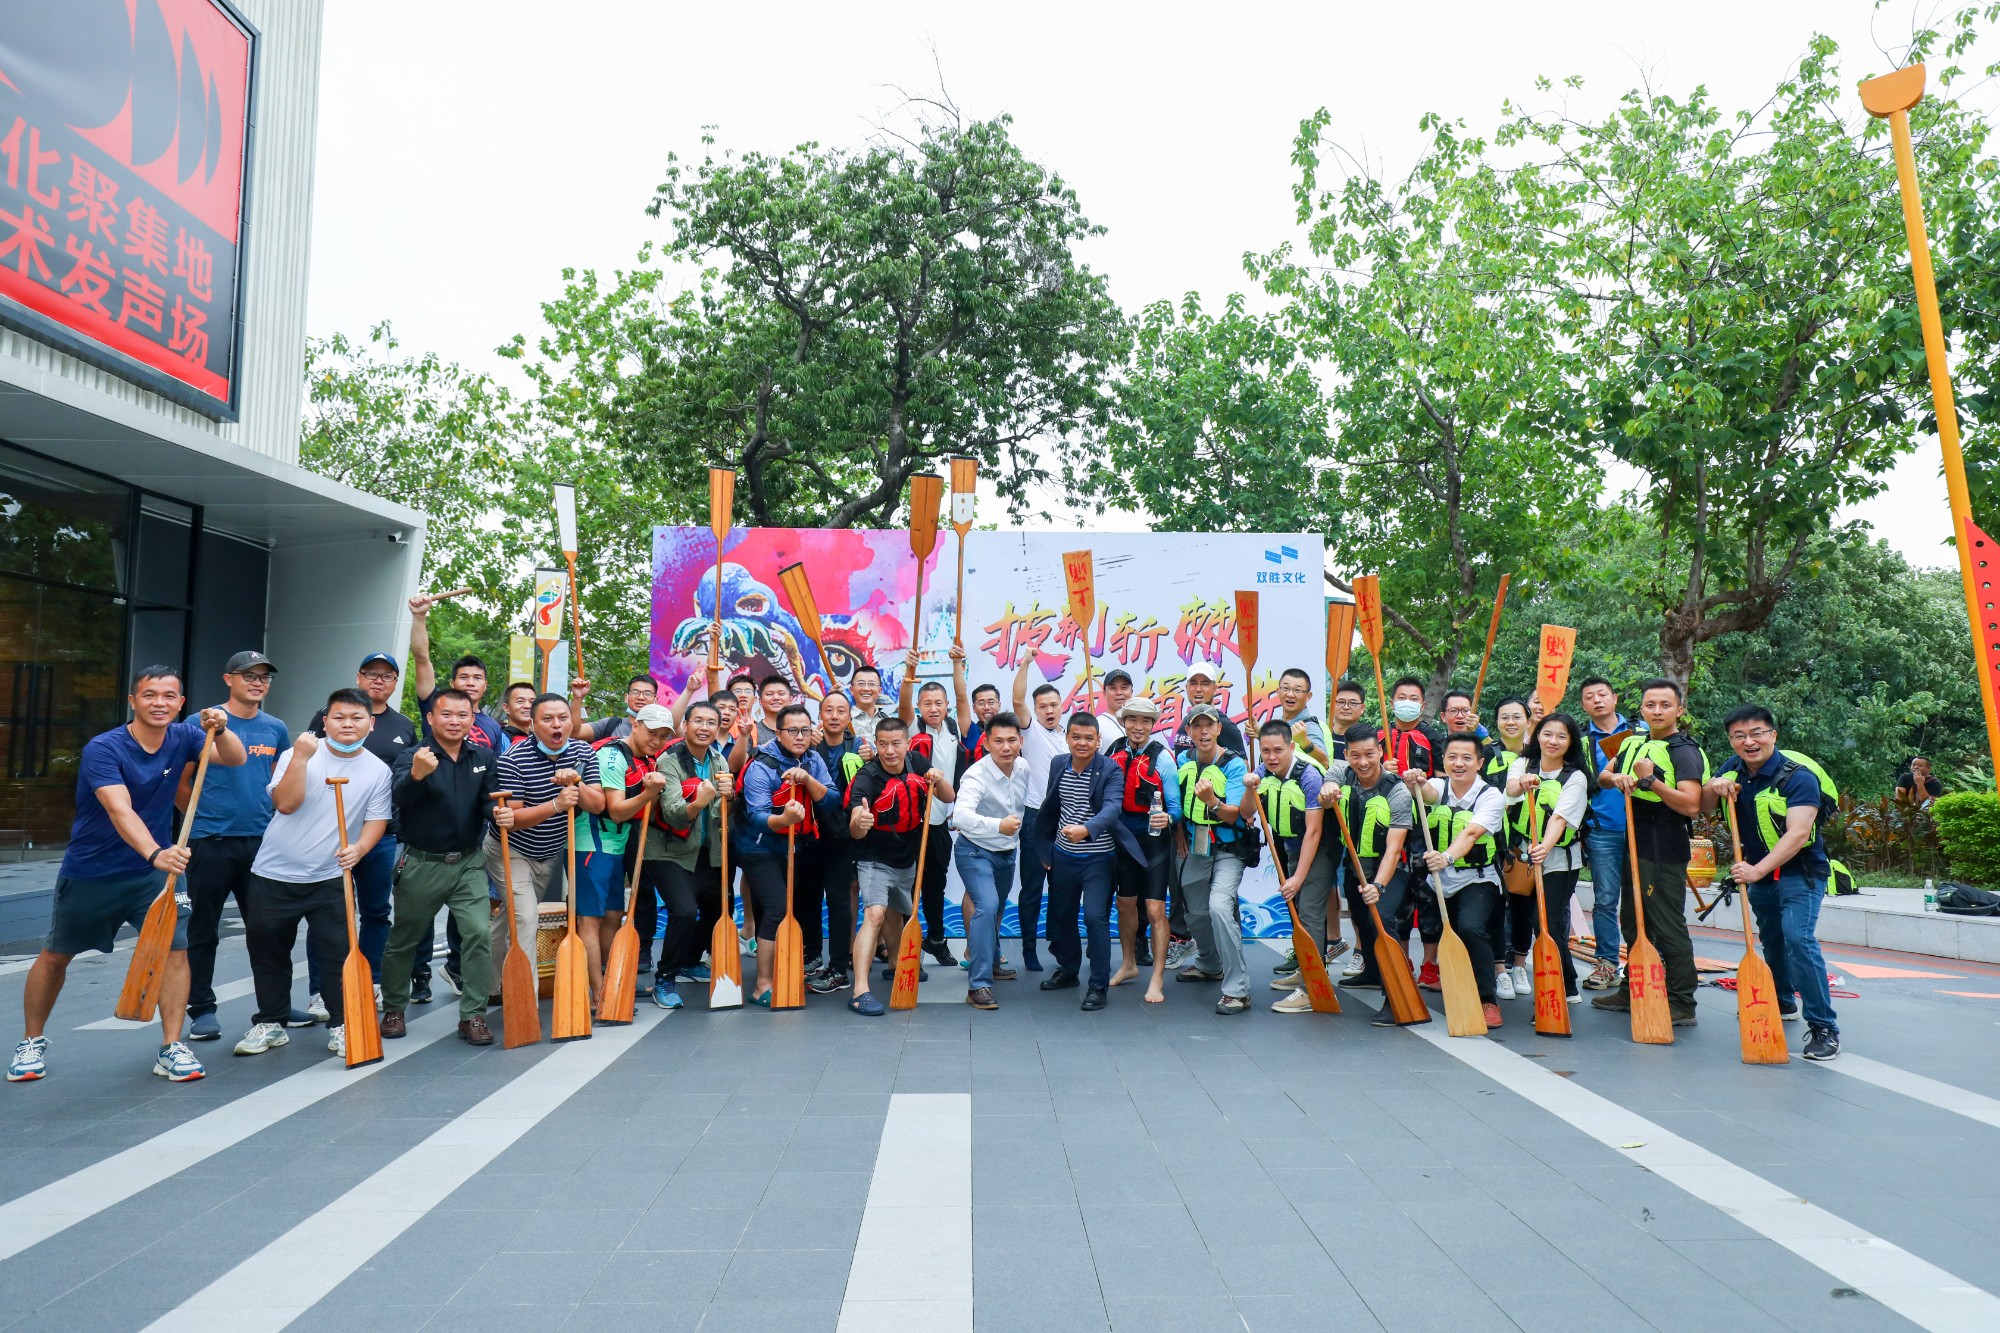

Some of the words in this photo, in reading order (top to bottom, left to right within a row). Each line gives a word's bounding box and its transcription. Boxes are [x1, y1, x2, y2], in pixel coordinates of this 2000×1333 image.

[0, 115, 213, 304] 化聚集地
[0, 204, 209, 369] 术发声场
[1256, 571, 1306, 584] 双胜文化
